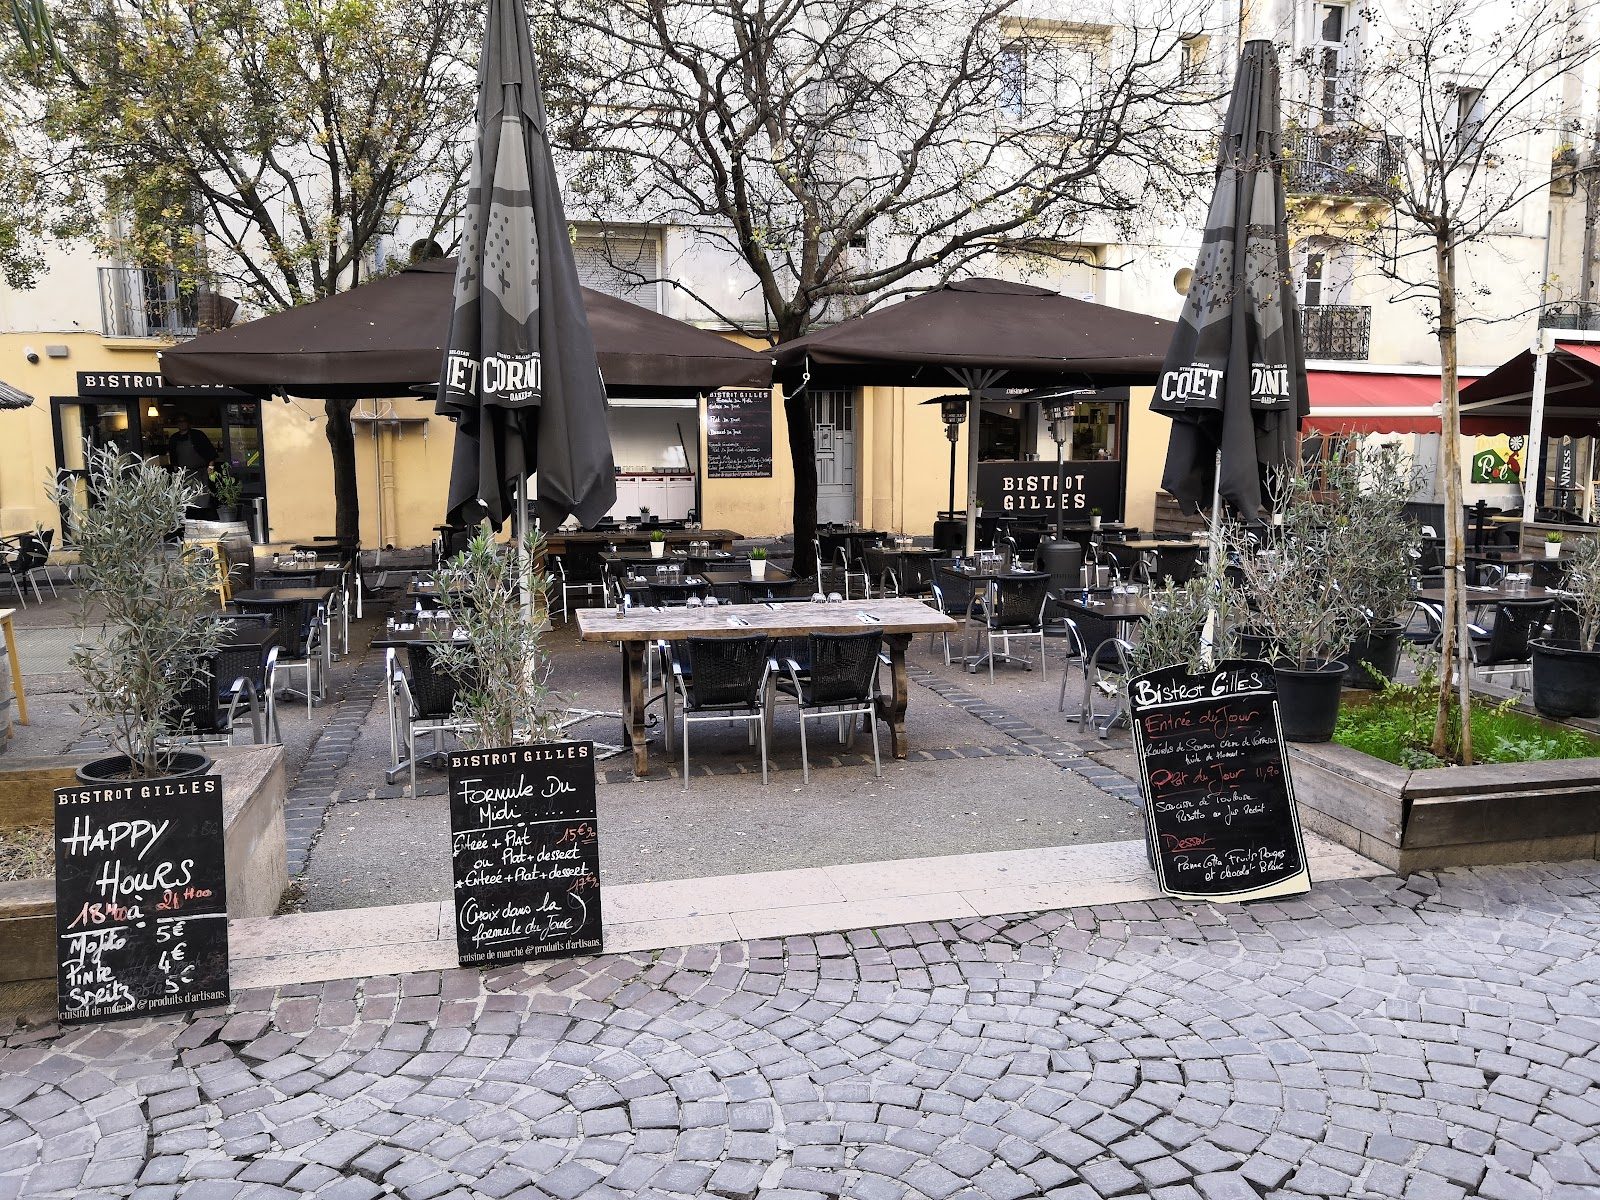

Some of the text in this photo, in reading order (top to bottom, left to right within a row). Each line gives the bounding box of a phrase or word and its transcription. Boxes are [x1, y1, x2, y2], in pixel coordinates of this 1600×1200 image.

[84, 374, 163, 389] BISTROT
[1003, 493, 1086, 511] GILLES
[1199, 709, 1218, 724] du
[1213, 705, 1260, 739] Jour
[451, 746, 589, 768] BISTROT GILLES
[541, 775, 577, 798] Du
[1193, 768, 1209, 783] du
[1208, 763, 1246, 795] Jour
[58, 780, 216, 805] BISTROT GILLES
[479, 800, 522, 828] Midi
[474, 858, 494, 869] ou
[501, 847, 528, 865] Plat
[536, 842, 581, 863] dessert
[514, 863, 541, 882] Plat
[549, 861, 589, 880] dessert
[127, 894, 145, 921] à
[502, 901, 532, 919] dans
[535, 892, 562, 912] la
[524, 918, 542, 935] du
[459, 952, 487, 963] cuisine
[486, 949, 496, 960] de
[496, 946, 524, 960] marché
[534, 940, 565, 956] produits
[91, 1005, 102, 1017] de
[148, 992, 184, 1008] produits
